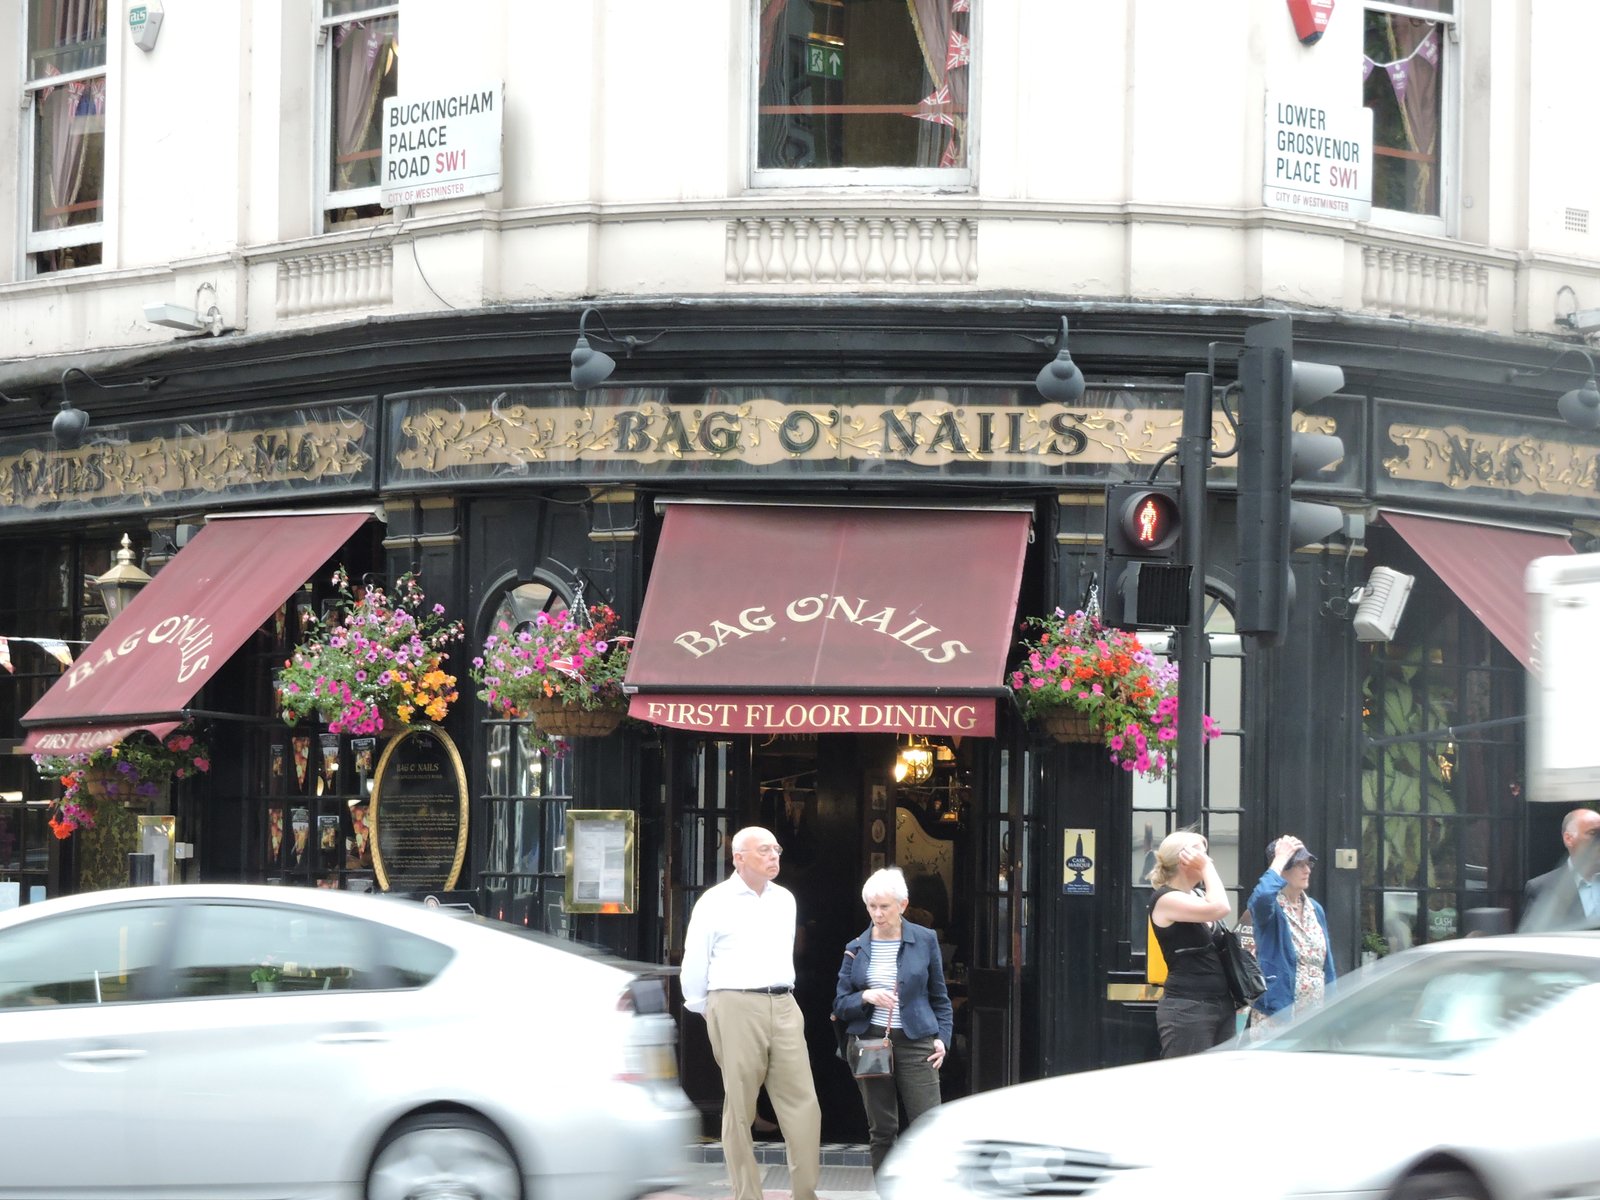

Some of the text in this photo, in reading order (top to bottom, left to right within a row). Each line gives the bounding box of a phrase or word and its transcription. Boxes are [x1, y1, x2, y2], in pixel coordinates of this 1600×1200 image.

[390, 91, 493, 127] BUCKINGHAM
[1278, 102, 1326, 131] LOWER
[389, 125, 447, 154] PALACE
[1277, 130, 1360, 163] GROSVENOR
[388, 149, 466, 181] ROAD SW1
[1276, 157, 1358, 190] PLACE SW1
[388, 183, 465, 203] CITY OF WESTMINSTER
[1275, 191, 1350, 212] CITY OF WESTMINSTER
[613, 409, 1089, 456] BAG O' NAILS
[673, 605, 777, 660] BAG
[65, 628, 147, 692] BAG
[647, 702, 978, 730] FIRST FLOOR DINING
[35, 732, 78, 749] FIRST
[417, 762, 440, 773] NAILS
[1434, 916, 1453, 927] CASH
